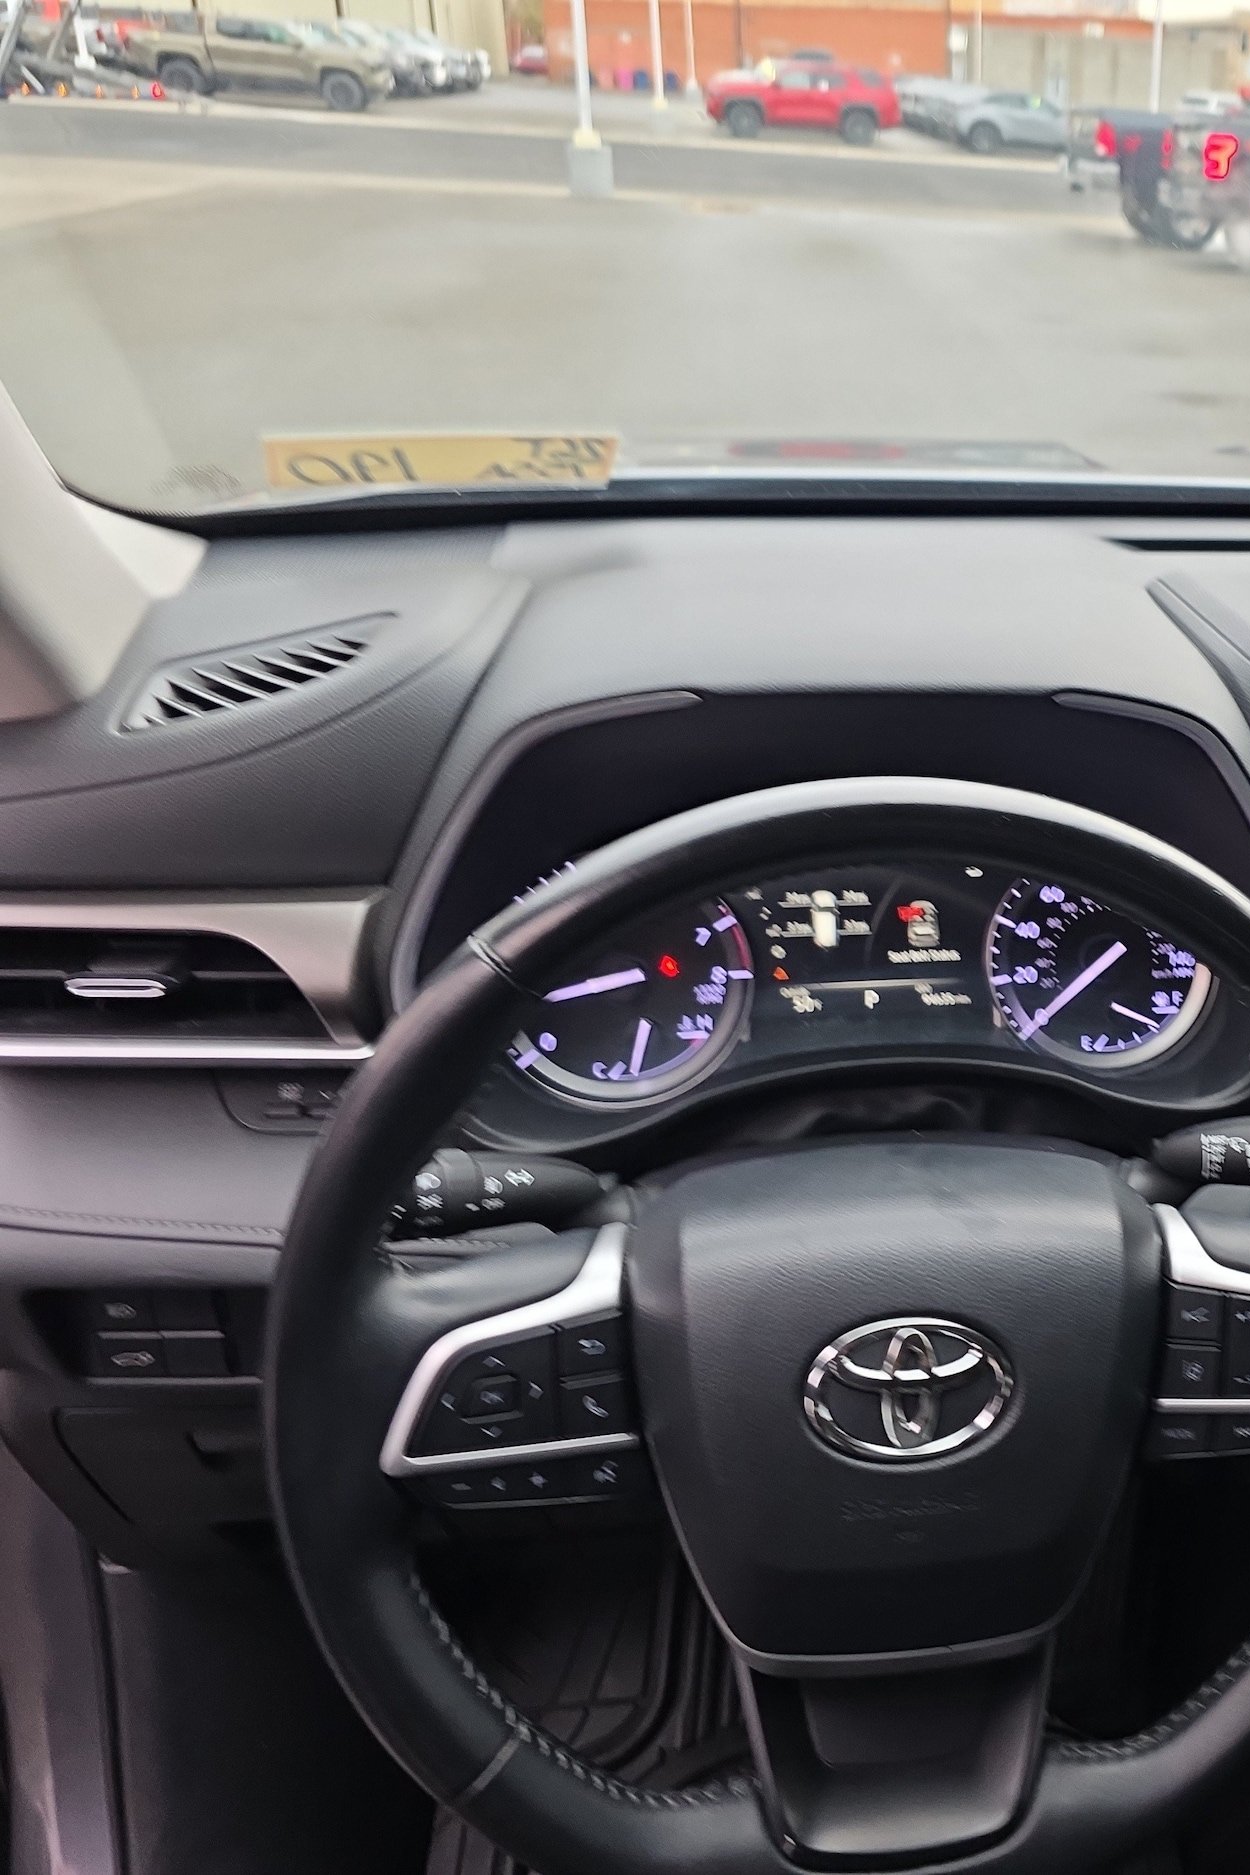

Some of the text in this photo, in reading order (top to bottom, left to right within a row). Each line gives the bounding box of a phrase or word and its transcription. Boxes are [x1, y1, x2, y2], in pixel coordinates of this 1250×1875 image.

[1040, 885, 1065, 904] 60
[864, 990, 880, 1010] P
[1080, 1035, 1094, 1052] E
[592, 1061, 608, 1079] C
